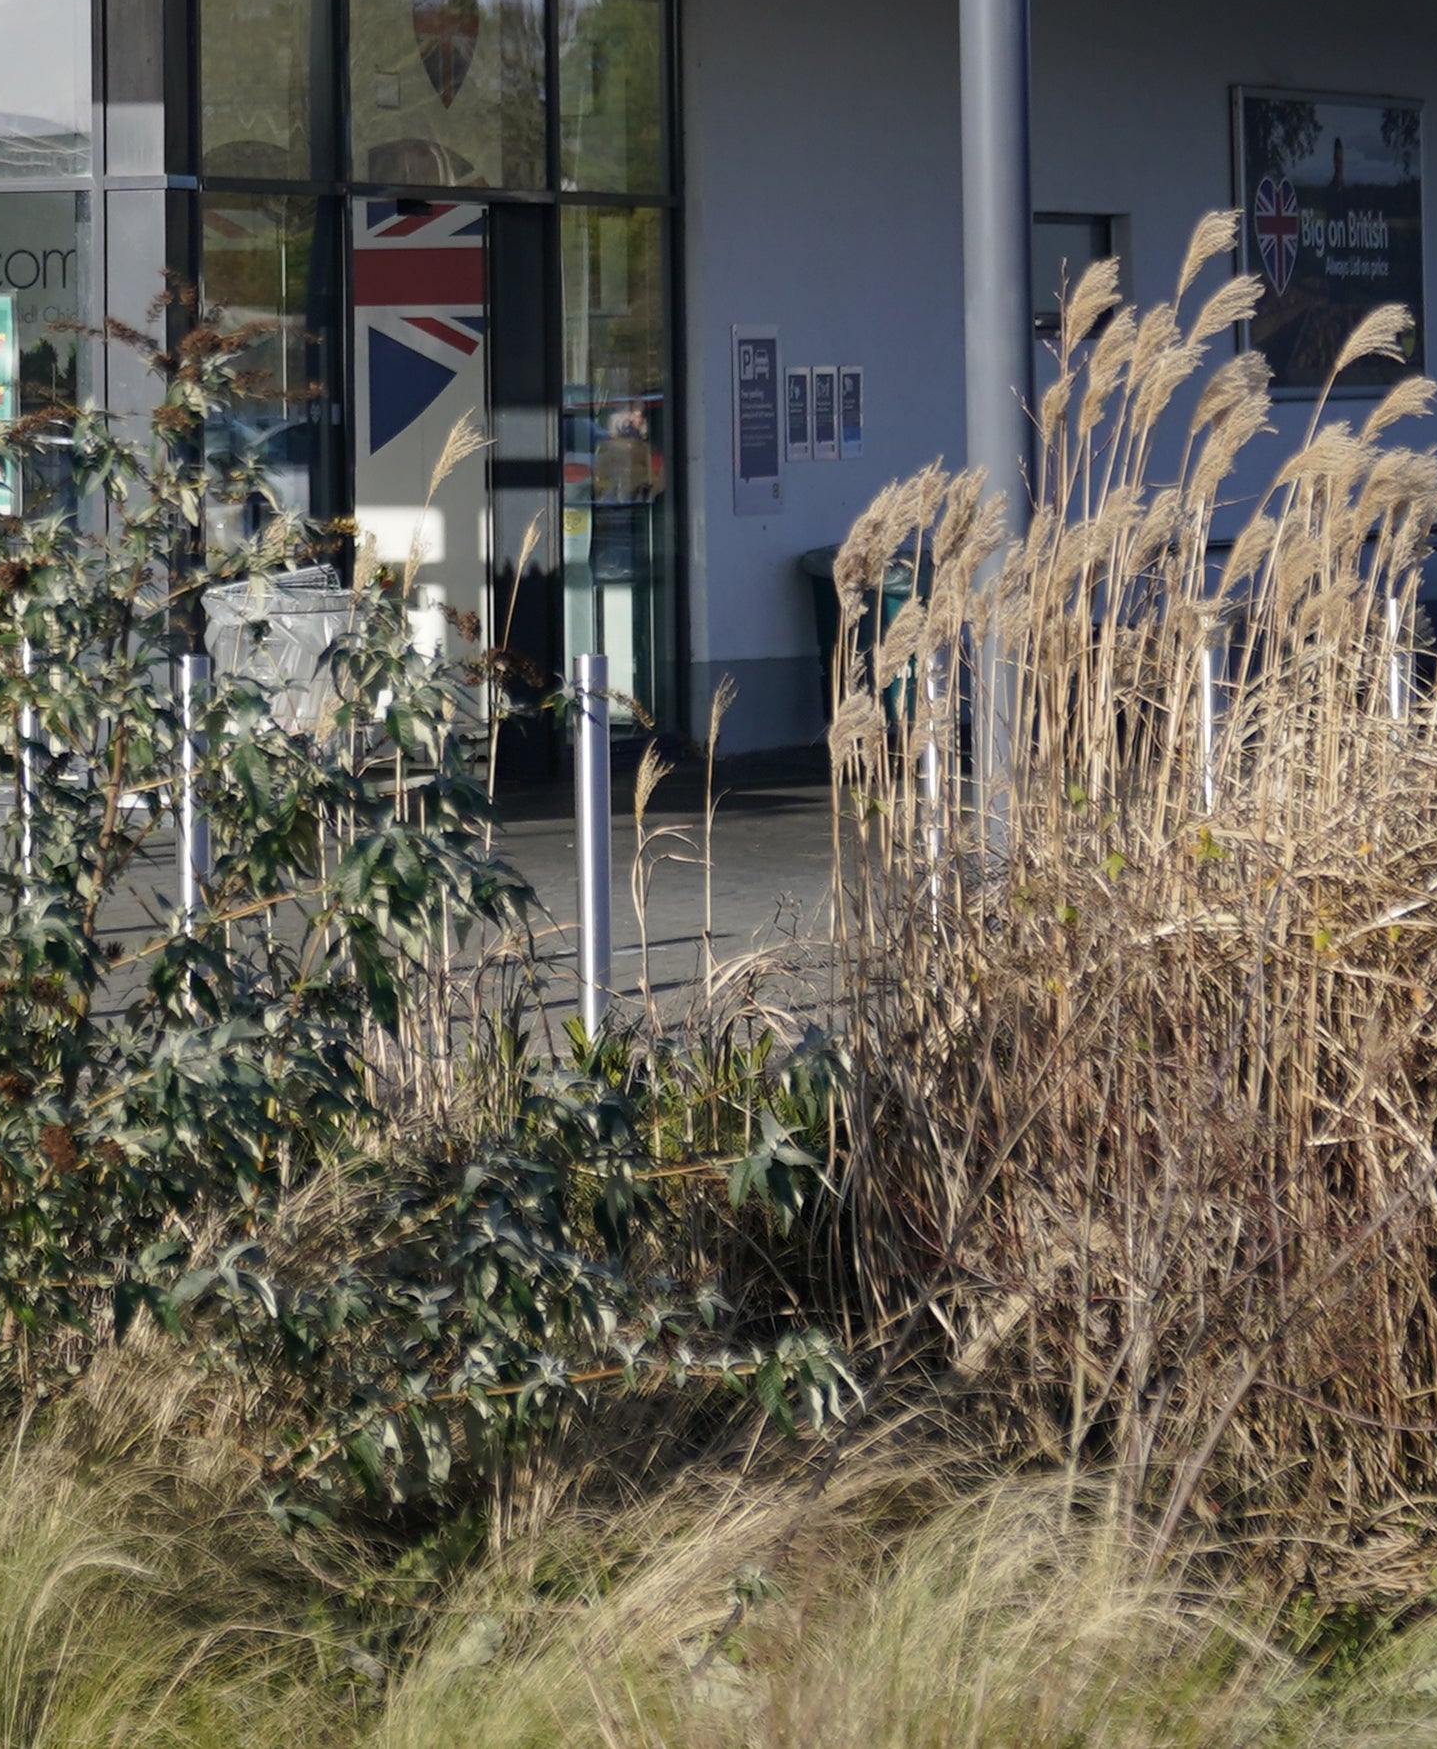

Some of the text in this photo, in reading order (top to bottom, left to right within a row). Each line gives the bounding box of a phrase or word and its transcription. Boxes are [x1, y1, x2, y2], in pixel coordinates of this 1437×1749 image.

[1301, 208, 1388, 258] Big on British
